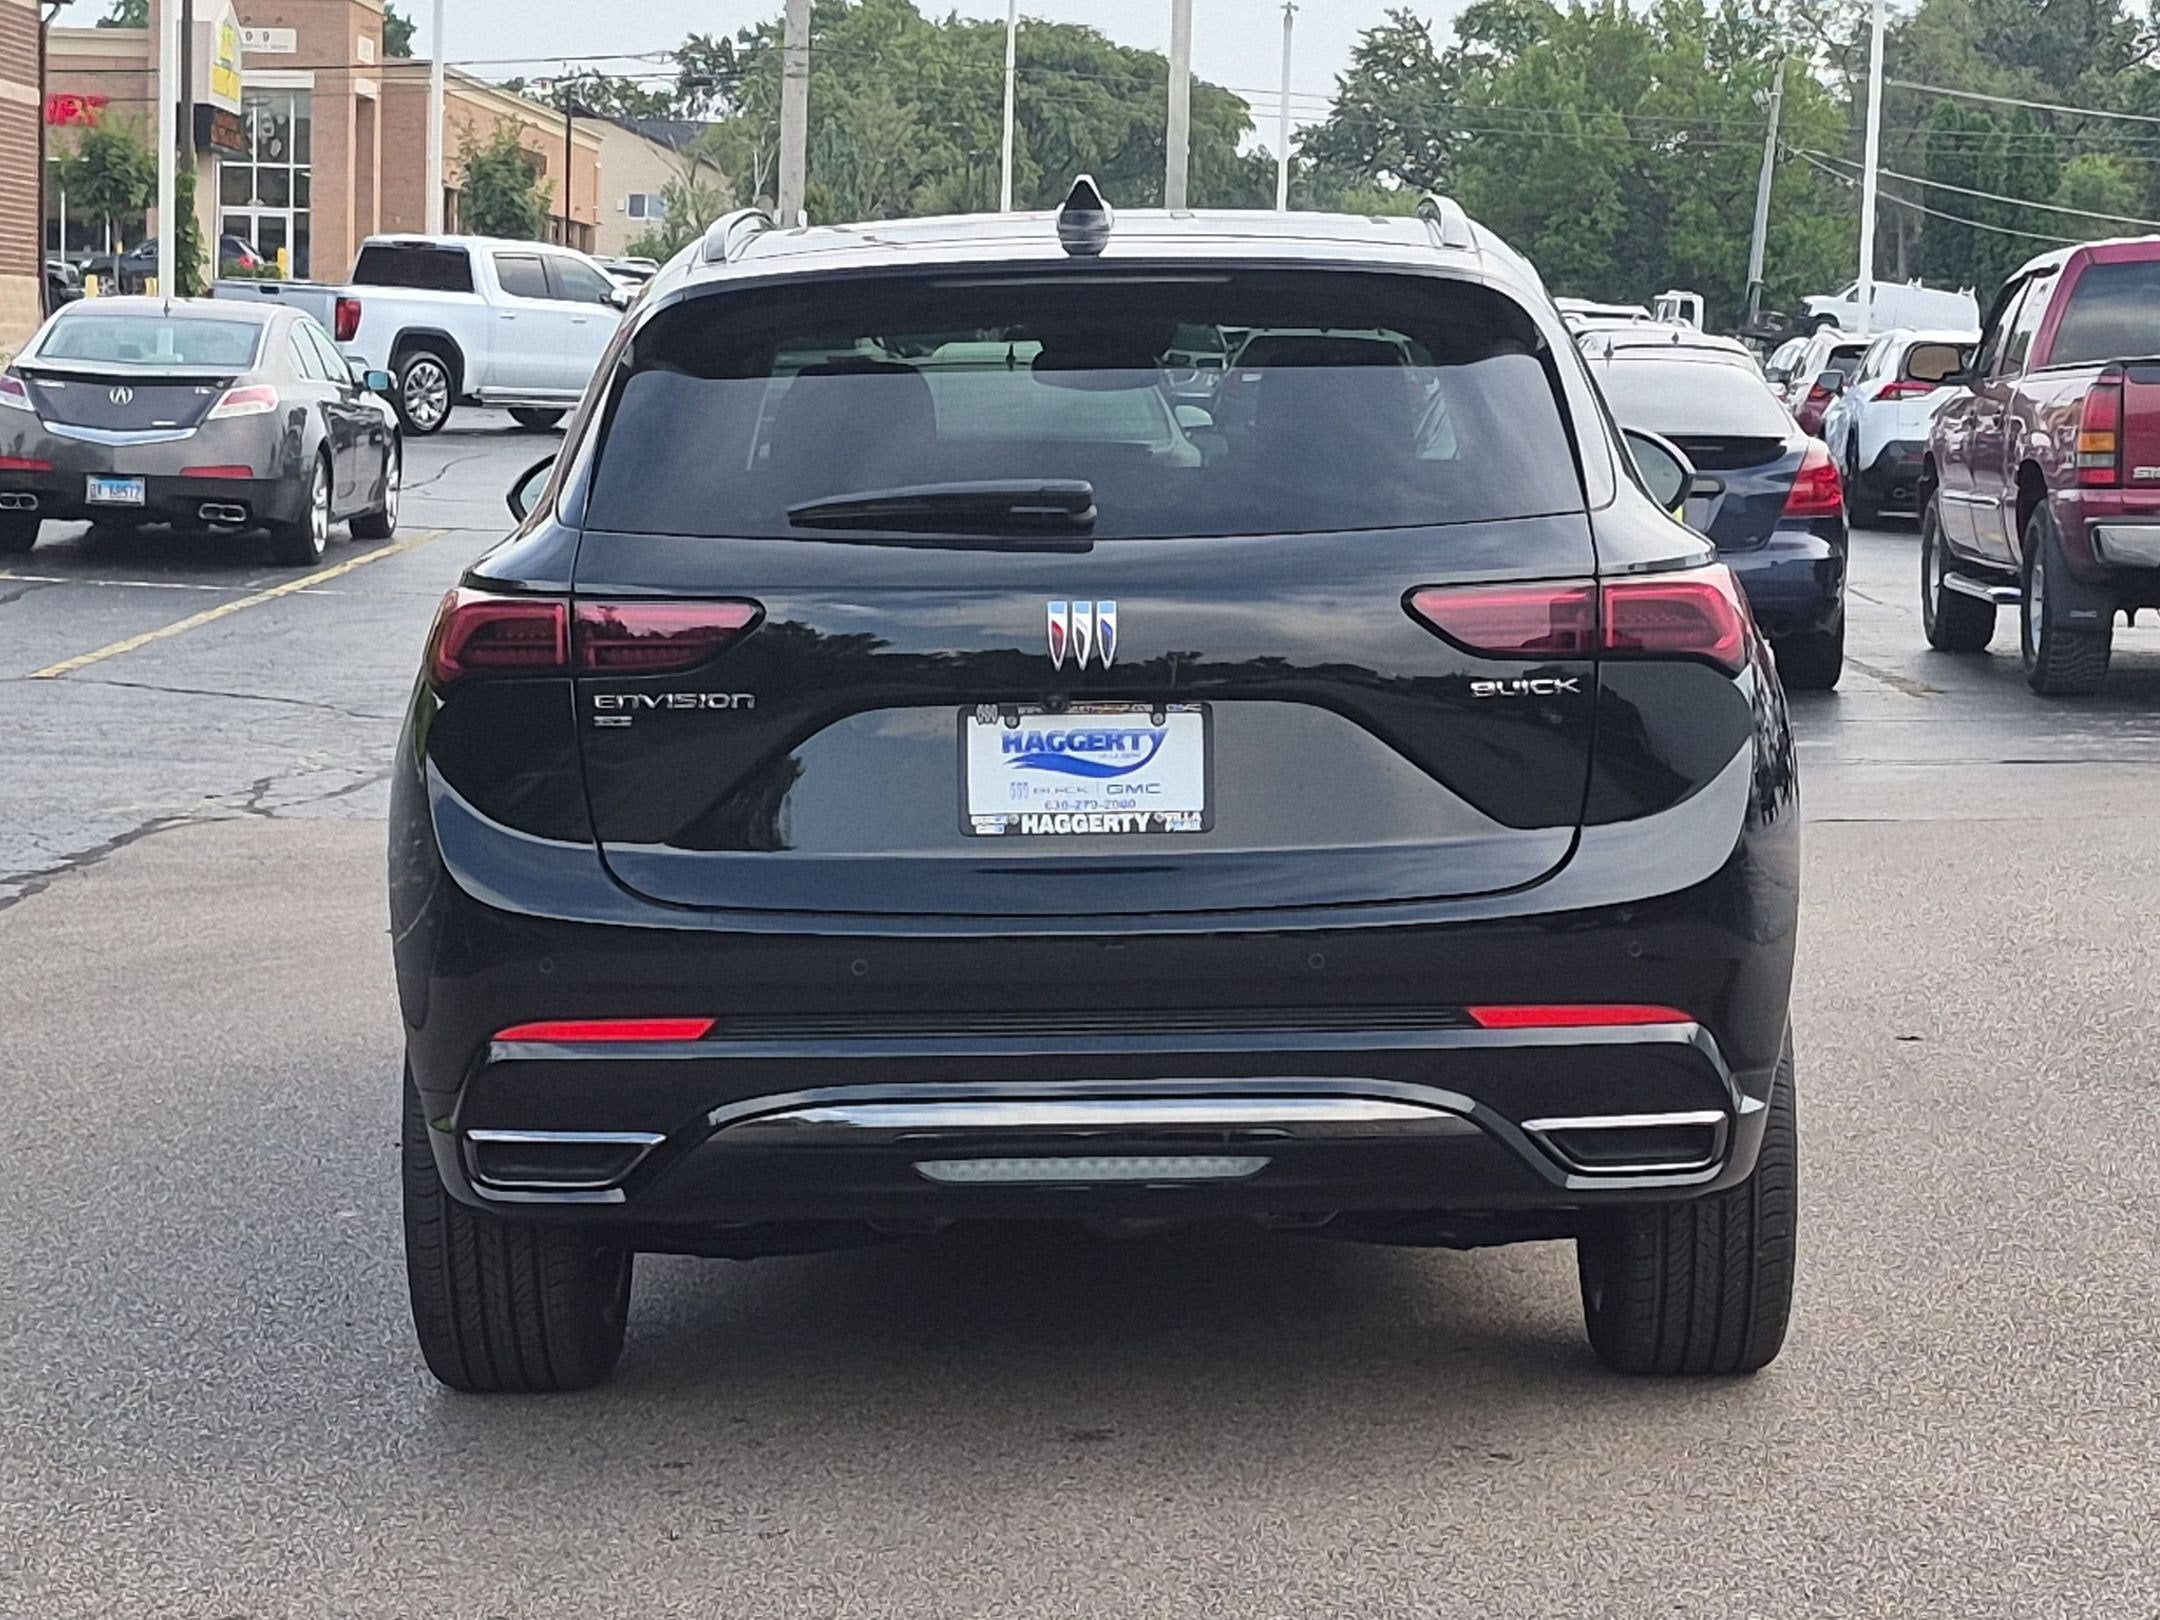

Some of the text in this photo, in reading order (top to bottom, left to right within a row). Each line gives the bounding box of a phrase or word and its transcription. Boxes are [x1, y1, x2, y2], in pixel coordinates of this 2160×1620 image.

[1470, 677, 1581, 697] BUICK
[594, 693, 755, 709] ENVISION
[1001, 728, 1169, 754] HAGGERTY
[1106, 782, 1162, 795] GMC
[1020, 813, 1150, 834] HAGGERTY
